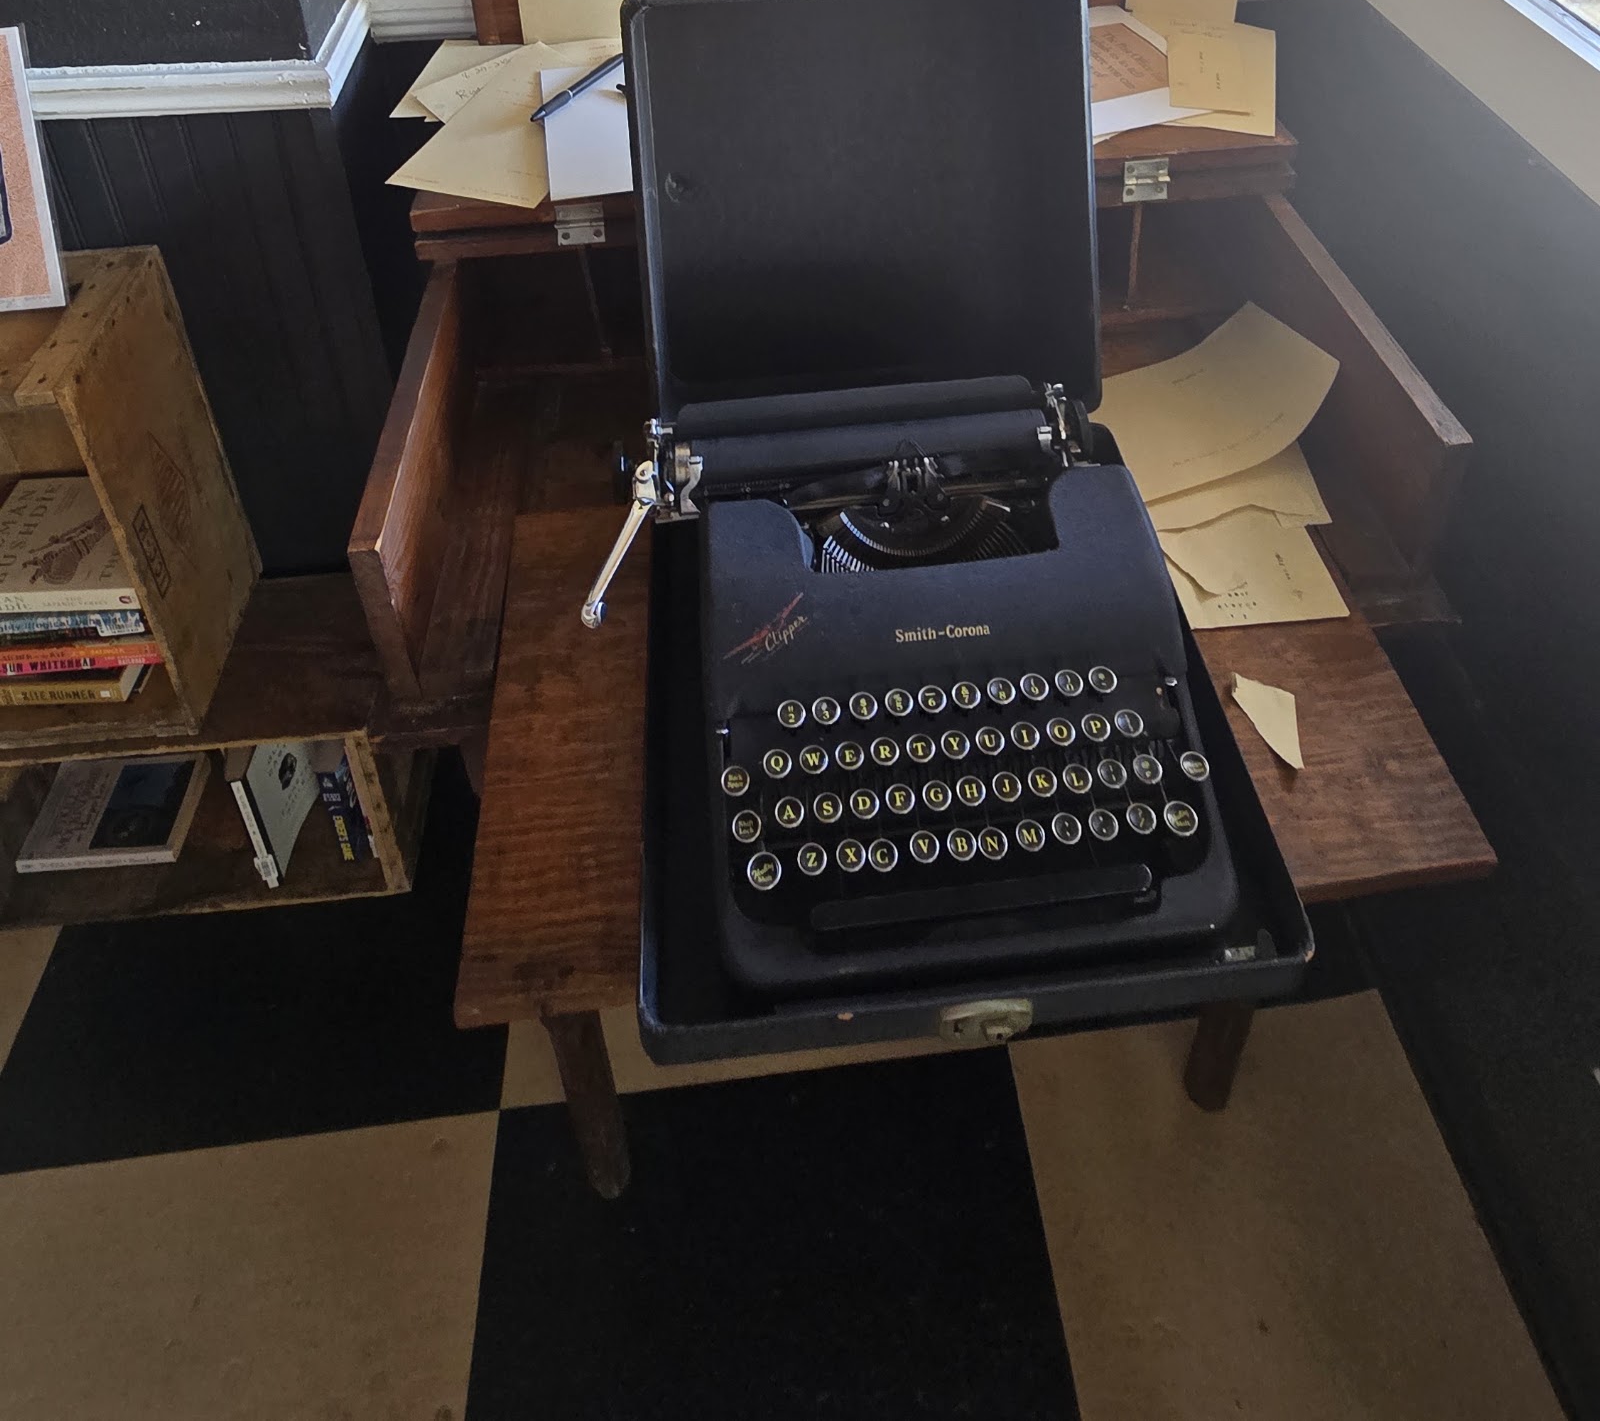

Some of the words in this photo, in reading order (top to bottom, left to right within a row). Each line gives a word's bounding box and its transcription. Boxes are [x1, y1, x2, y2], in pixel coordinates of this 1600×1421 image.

[765, 615, 808, 652] Clipper
[895, 624, 991, 643] Smith-Corona
[50, 689, 97, 700] RUNNER
[770, 756, 783, 771] Q
[806, 753, 821, 766] W
[845, 750, 856, 762] E
[880, 746, 891, 758] R
[913, 743, 926, 756] T
[948, 738, 960, 751] Y
[984, 735, 996, 747] U
[1054, 726, 1067, 738] O
[1090, 721, 1101, 733] P
[783, 805, 796, 820] A
[823, 801, 833, 815] S
[858, 797, 870, 810] D
[894, 791, 906, 806] F
[930, 788, 943, 802] G
[964, 784, 978, 798] H
[1036, 774, 1049, 788] K
[1073, 773, 1084, 786] L
[807, 852, 817, 867] Z
[845, 848, 857, 863] X
[876, 849, 889, 864] C
[917, 839, 930, 854] V
[956, 837, 968, 852] B
[986, 837, 999, 851] N
[1023, 830, 1038, 844] M
